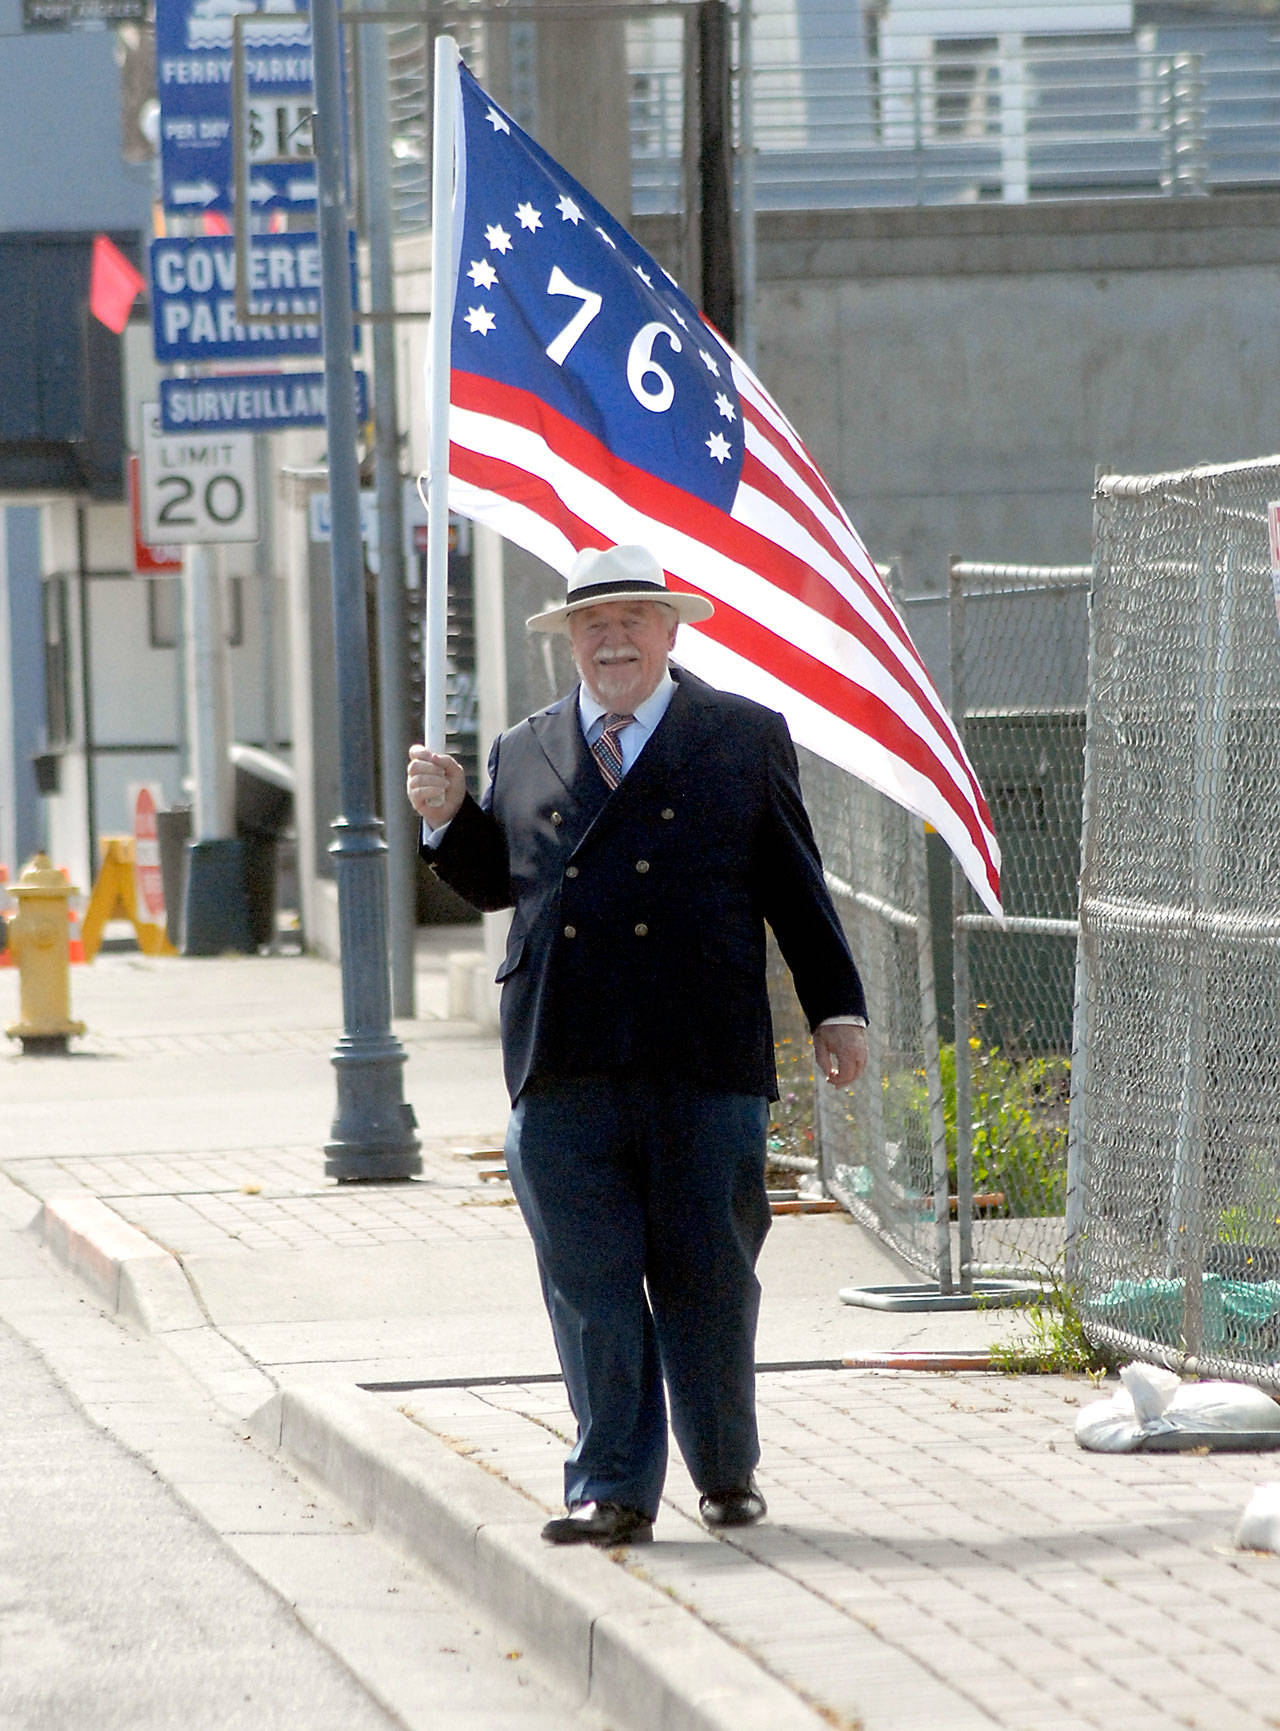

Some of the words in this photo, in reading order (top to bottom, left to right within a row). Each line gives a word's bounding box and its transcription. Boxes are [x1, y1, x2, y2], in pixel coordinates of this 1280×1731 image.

[161, 60, 233, 84] FERRY
[157, 247, 322, 294] COVERE
[164, 299, 320, 344] PARKIN
[161, 445, 233, 468] LIMIT
[157, 473, 244, 526] 20
